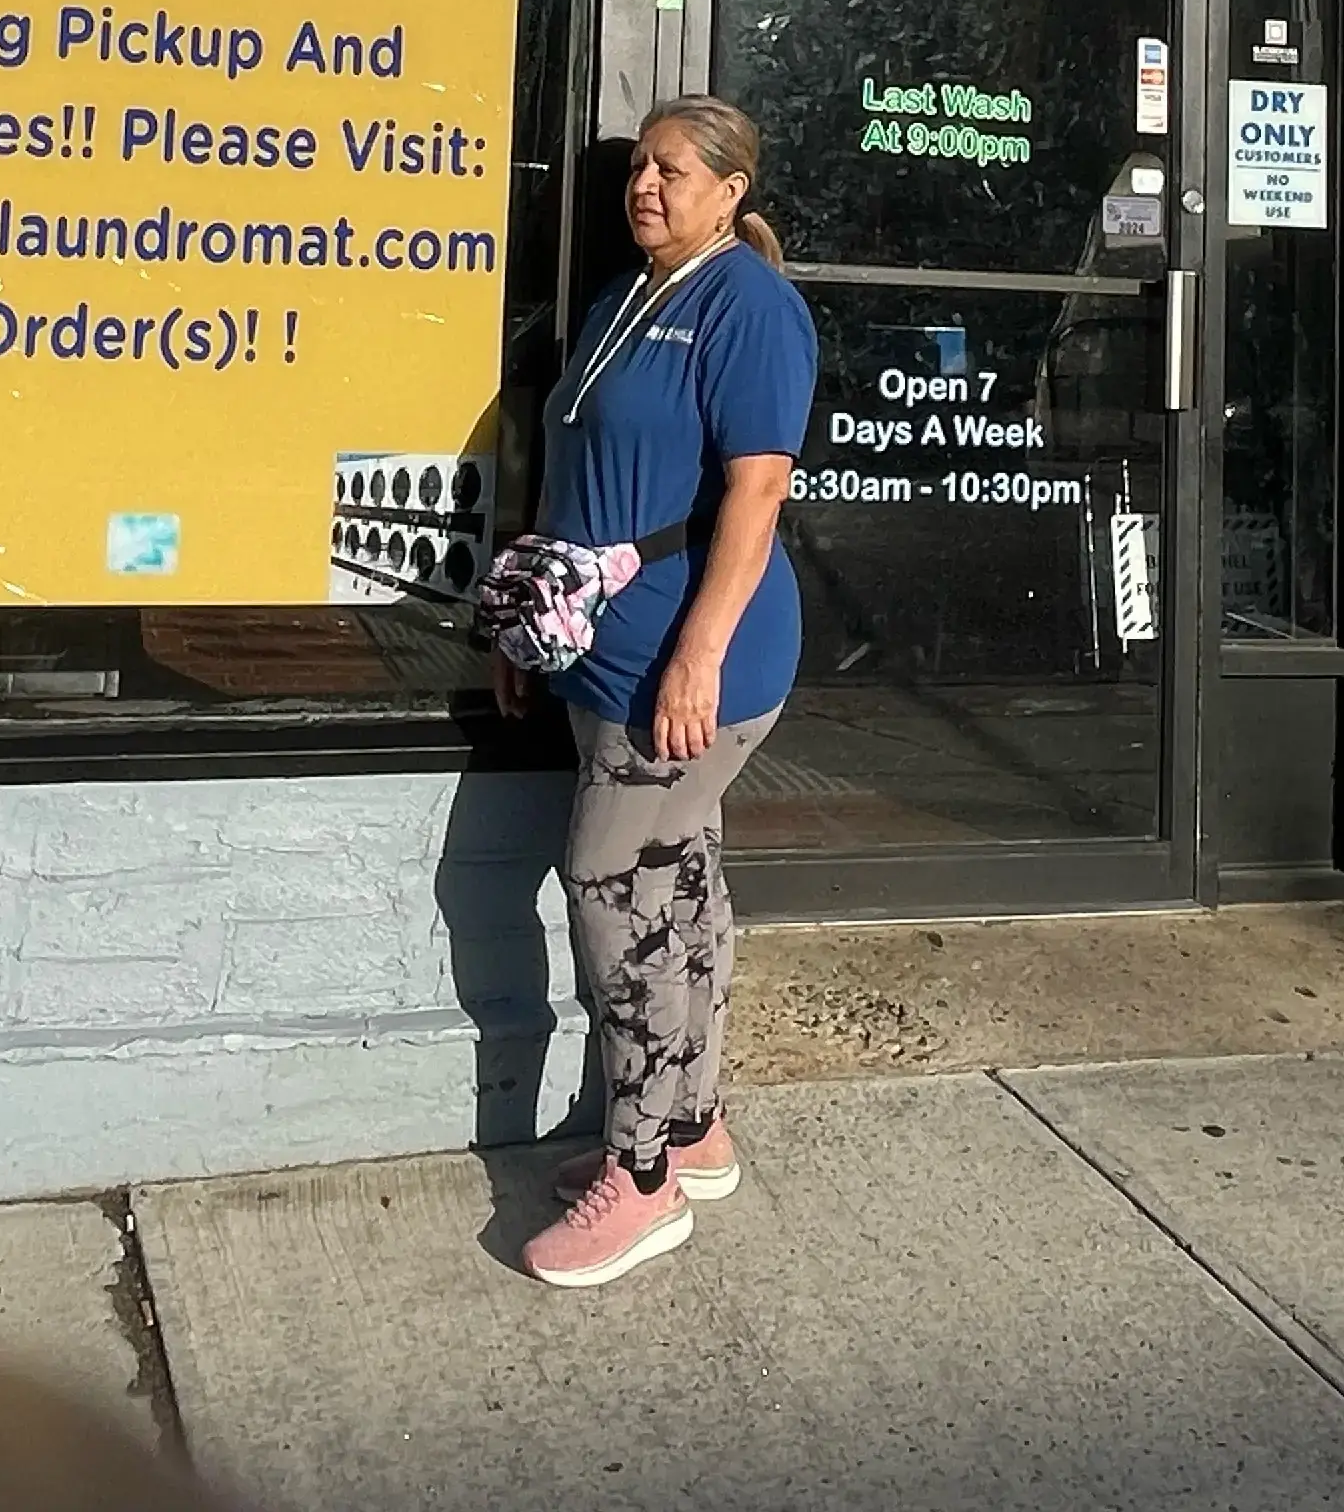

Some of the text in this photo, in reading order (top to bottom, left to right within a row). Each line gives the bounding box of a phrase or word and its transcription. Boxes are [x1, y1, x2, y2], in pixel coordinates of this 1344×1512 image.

[58, 6, 263, 75] Pickup
[287, 22, 403, 77] And
[861, 78, 1032, 123] Last Wash
[1250, 90, 1305, 114] DRY
[122, 108, 317, 170] Please
[342, 119, 488, 178] Visit:
[860, 125, 1031, 170] At 9:00pm
[1240, 122, 1316, 148] ONLY
[1234, 148, 1322, 165] CUSTOMERS
[1242, 189, 1314, 204] WEEKEND
[1266, 174, 1290, 187] NO
[1264, 206, 1291, 219] USE
[879, 369, 998, 407] Open 7
[831, 414, 1045, 452] Days A Week
[788, 469, 913, 503] 6:30am
[941, 471, 1081, 510] 10:30pm
